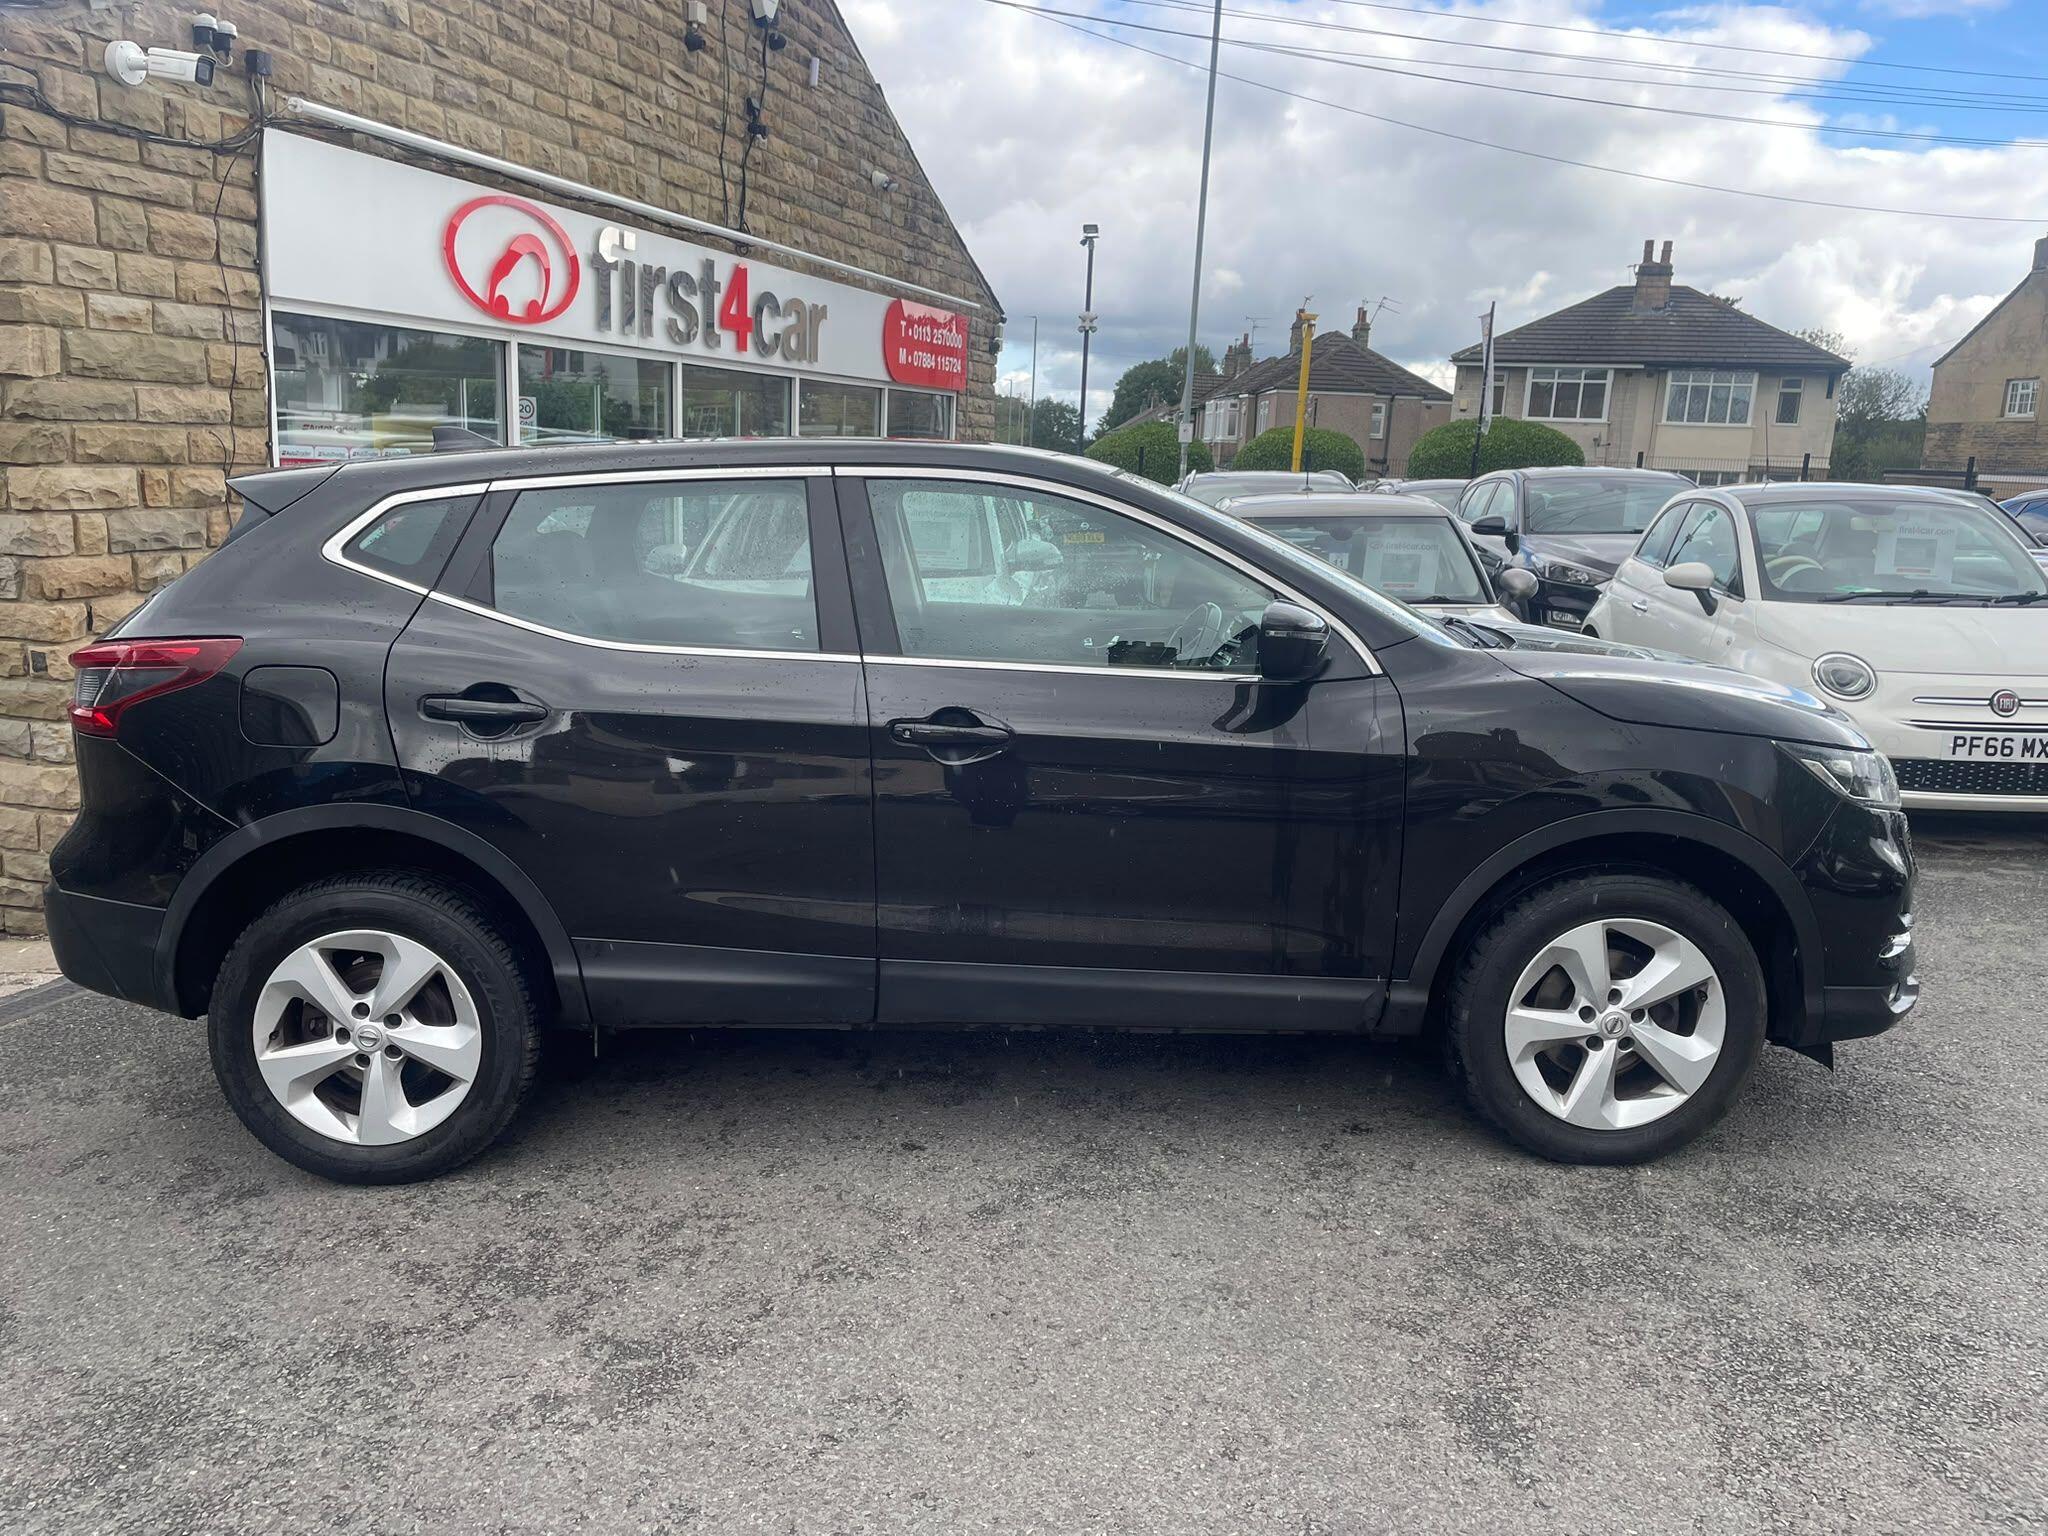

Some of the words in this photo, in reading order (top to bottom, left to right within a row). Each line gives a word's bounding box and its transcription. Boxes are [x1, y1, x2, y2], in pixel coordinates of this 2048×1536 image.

[592, 227, 828, 363] first4car
[900, 321, 907, 337] T
[913, 324, 931, 342] 0113
[899, 348, 906, 365] M
[913, 351, 935, 369] 07884
[937, 355, 961, 373] 115724
[2000, 698, 2014, 710] FIAT
[1951, 735, 2014, 757] PF66
[2020, 737, 2048, 758] MX
